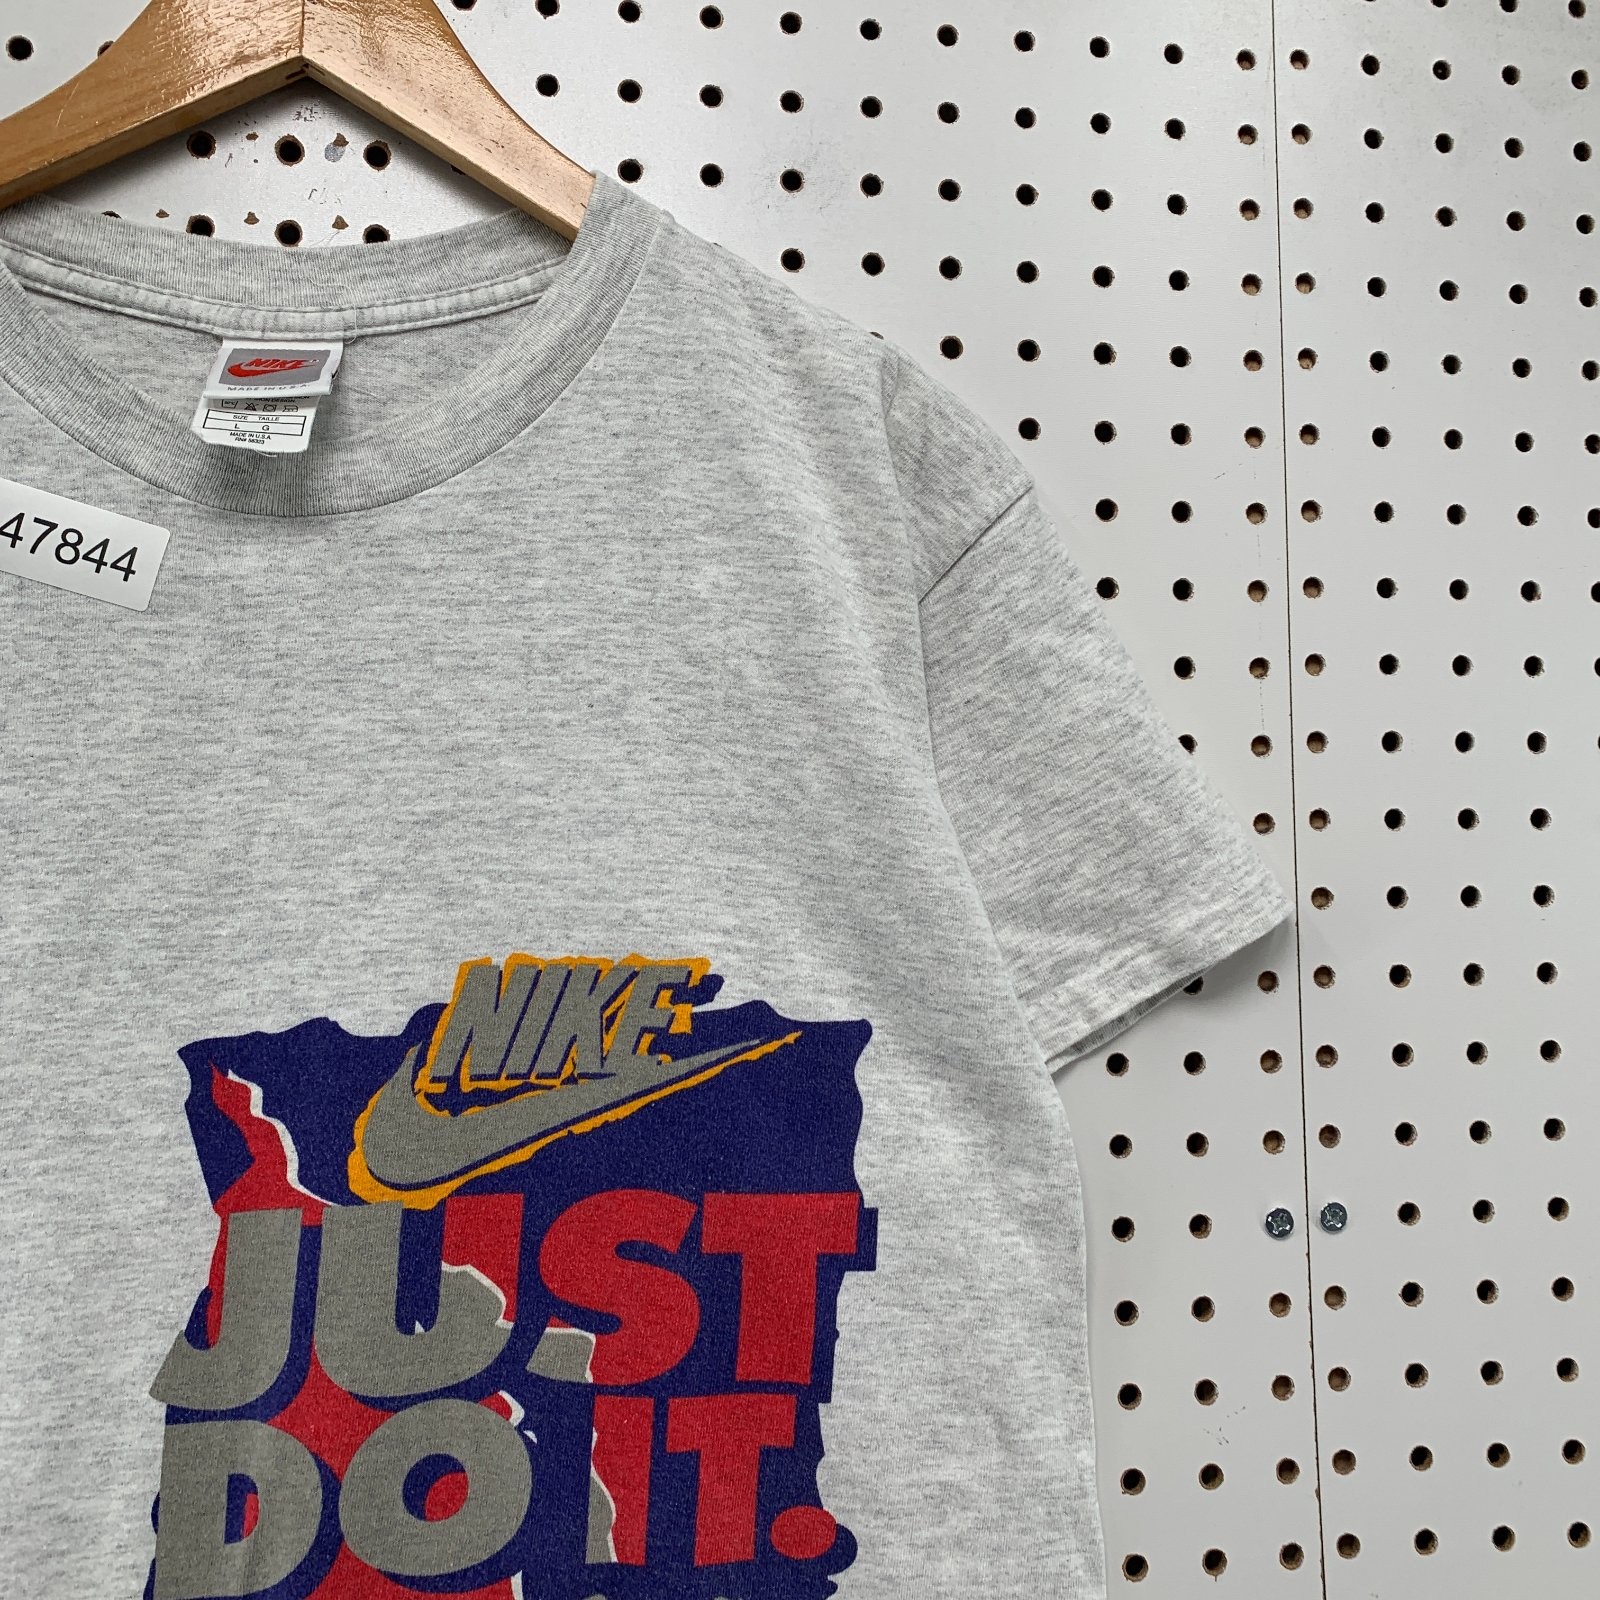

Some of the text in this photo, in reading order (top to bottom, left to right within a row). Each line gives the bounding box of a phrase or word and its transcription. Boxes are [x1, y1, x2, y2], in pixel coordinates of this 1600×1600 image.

[244, 358, 306, 369] NIKE
[0, 512, 138, 582] 47844
[425, 955, 708, 1085] NIKE
[149, 1189, 859, 1412] JUST
[153, 1394, 837, 1600] DO IT.
